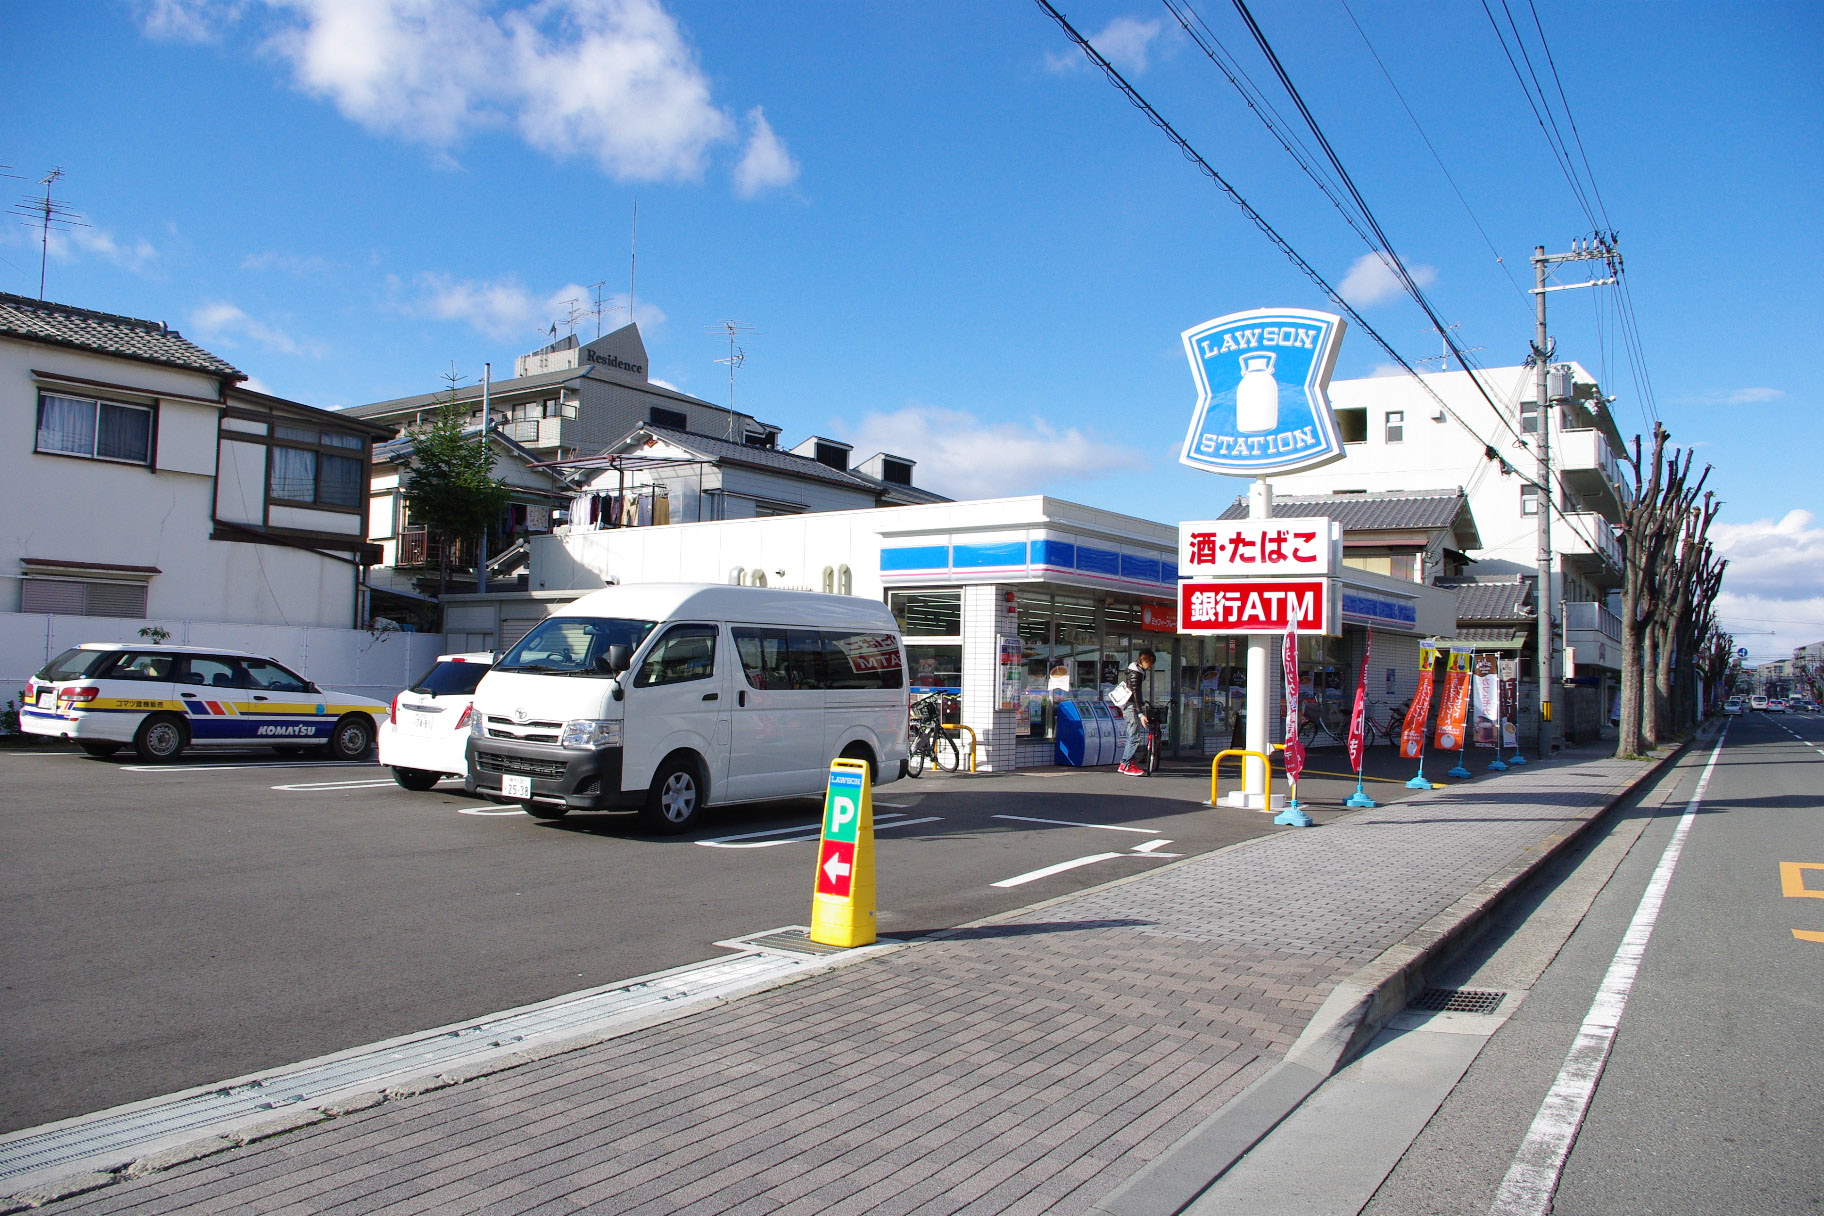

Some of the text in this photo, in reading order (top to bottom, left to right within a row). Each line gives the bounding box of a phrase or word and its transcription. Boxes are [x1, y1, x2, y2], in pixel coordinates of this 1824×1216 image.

[1201, 327, 1317, 359] LAWSON
[586, 348, 643, 374] Residence
[1200, 426, 1316, 456] STATION
[1189, 530, 1317, 565] 酒・たばこ
[1190, 590, 1314, 622] 銀行ATM
[257, 724, 316, 735] KOMATSU
[831, 775, 861, 786] LAWSON
[831, 796, 855, 833] P
